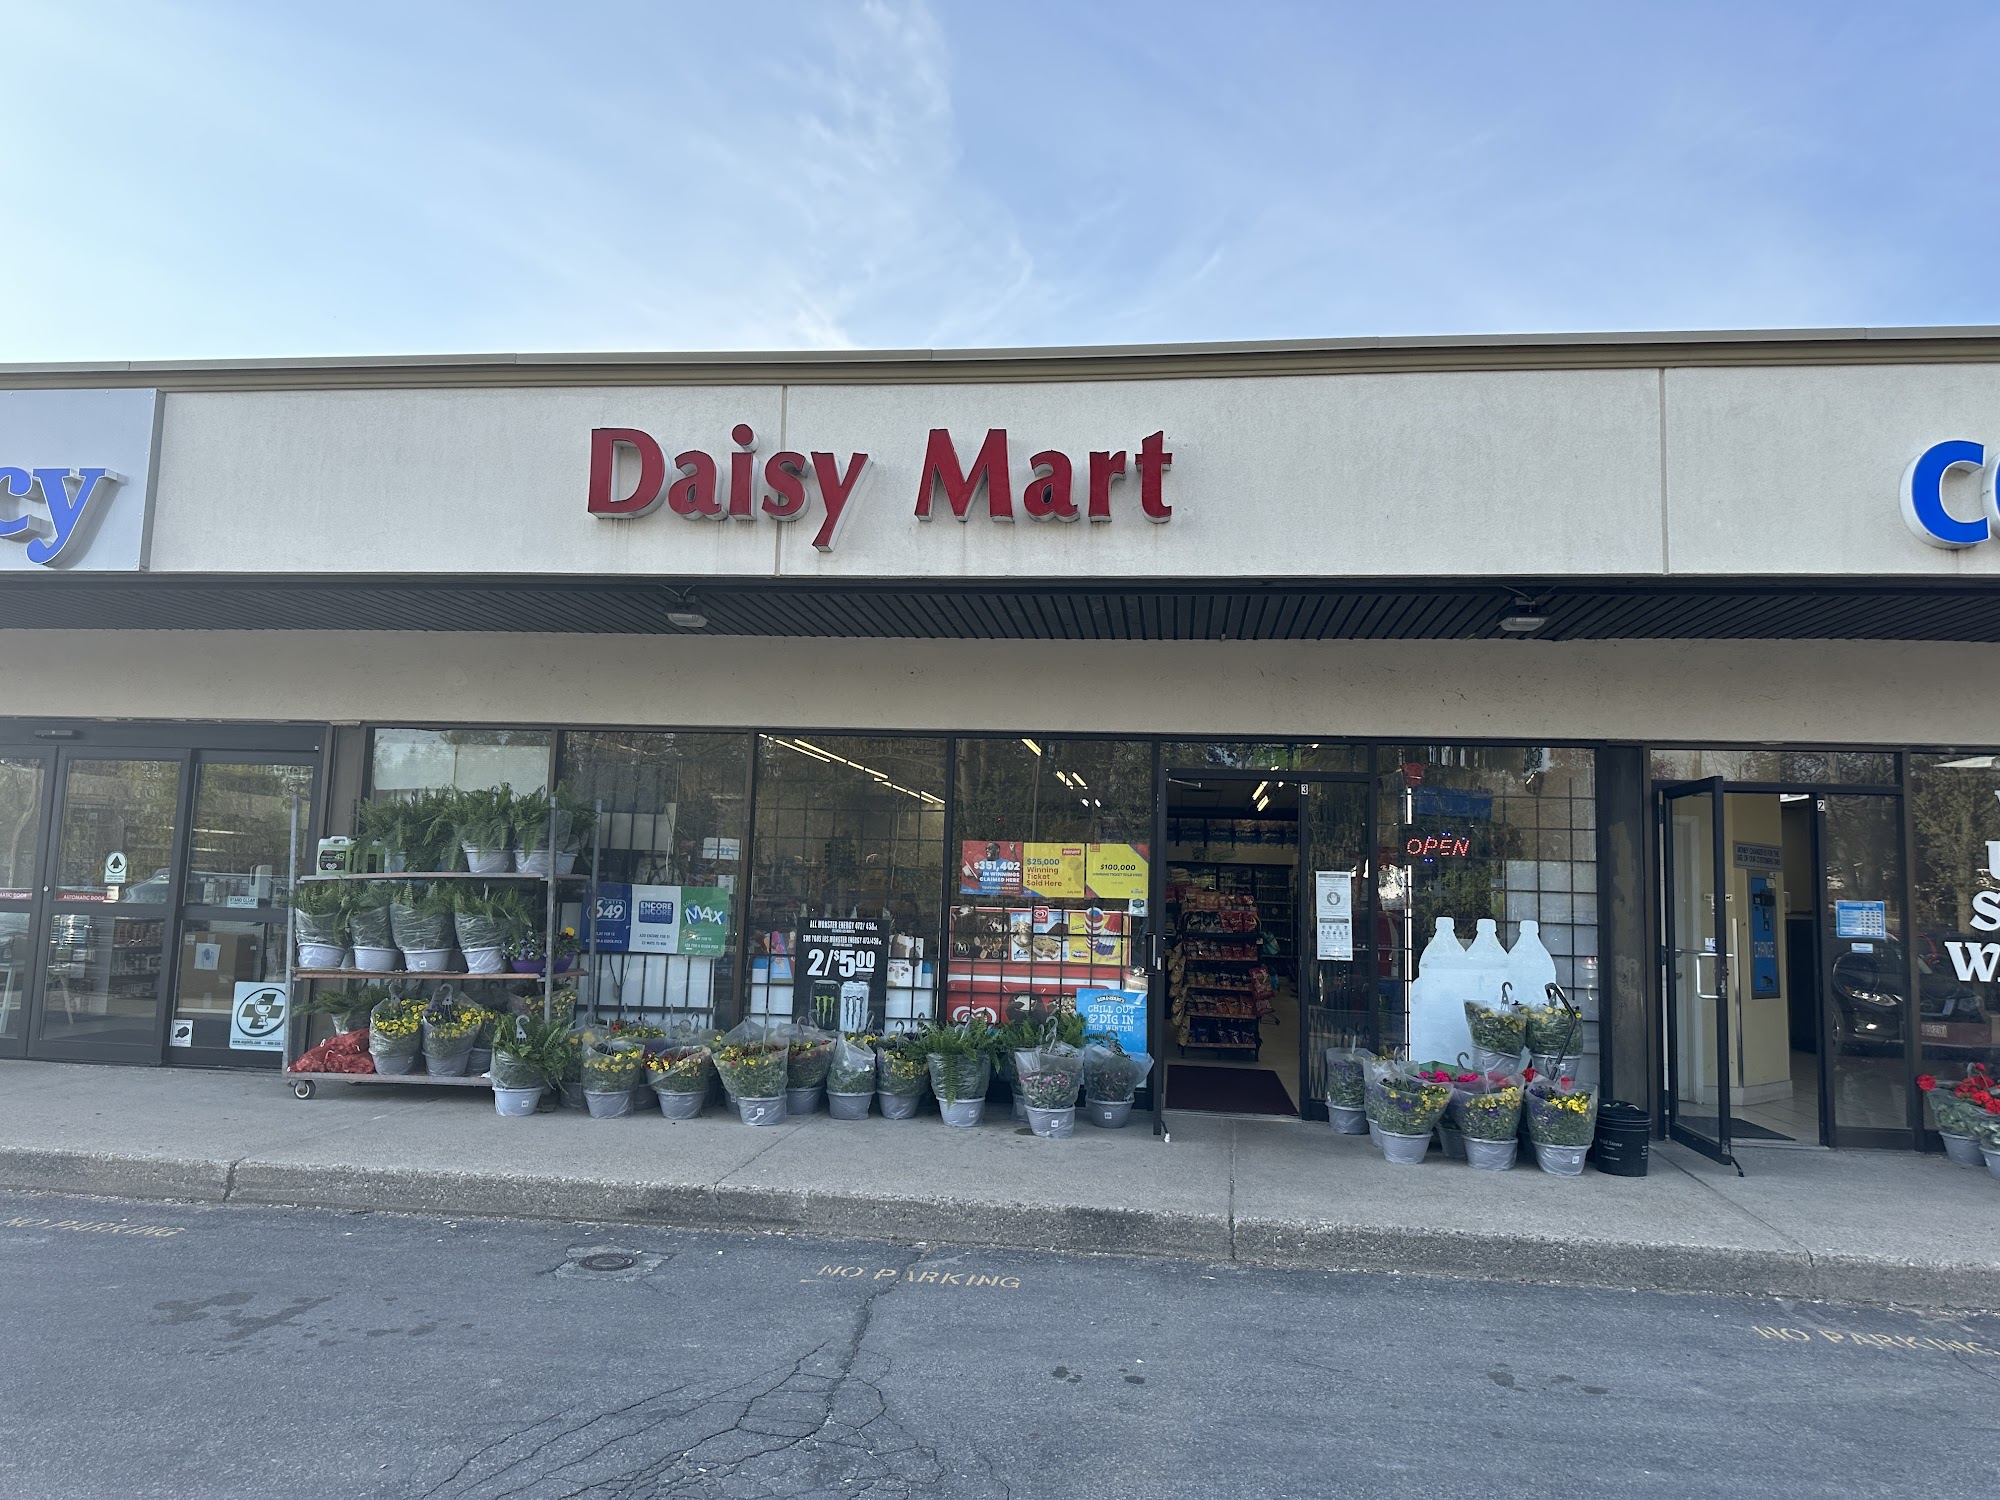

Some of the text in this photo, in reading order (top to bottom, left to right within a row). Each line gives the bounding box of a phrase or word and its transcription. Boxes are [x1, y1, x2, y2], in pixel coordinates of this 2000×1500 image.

[588, 424, 1173, 552] Daisy Mart
[1899, 439, 2000, 549] C
[1407, 838, 1470, 857] OPEN
[974, 861, 1020, 871] $351,402
[1027, 858, 1060, 866] $25,000
[1026, 866, 1059, 875] Winning
[640, 901, 672, 909] ENCORE
[683, 899, 697, 907] Lotto
[685, 905, 723, 925] MAX
[809, 920, 818, 929] ALL
[818, 920, 837, 929] MONSTER
[838, 921, 854, 930] ENERGY
[830, 936, 847, 944] MONSTER
[848, 936, 862, 944] ENERGY
[1944, 941, 2000, 982] W
[1087, 1004, 1135, 1014] CHILL OUT
[1088, 1014, 1135, 1025] & DIG IN
[1105, 1024, 1134, 1032] WINTER!
[2, 1217, 186, 1237] NO PARKING
[816, 1264, 1022, 1289] NO PARKING
[1751, 1325, 2000, 1357] NO PARKING
